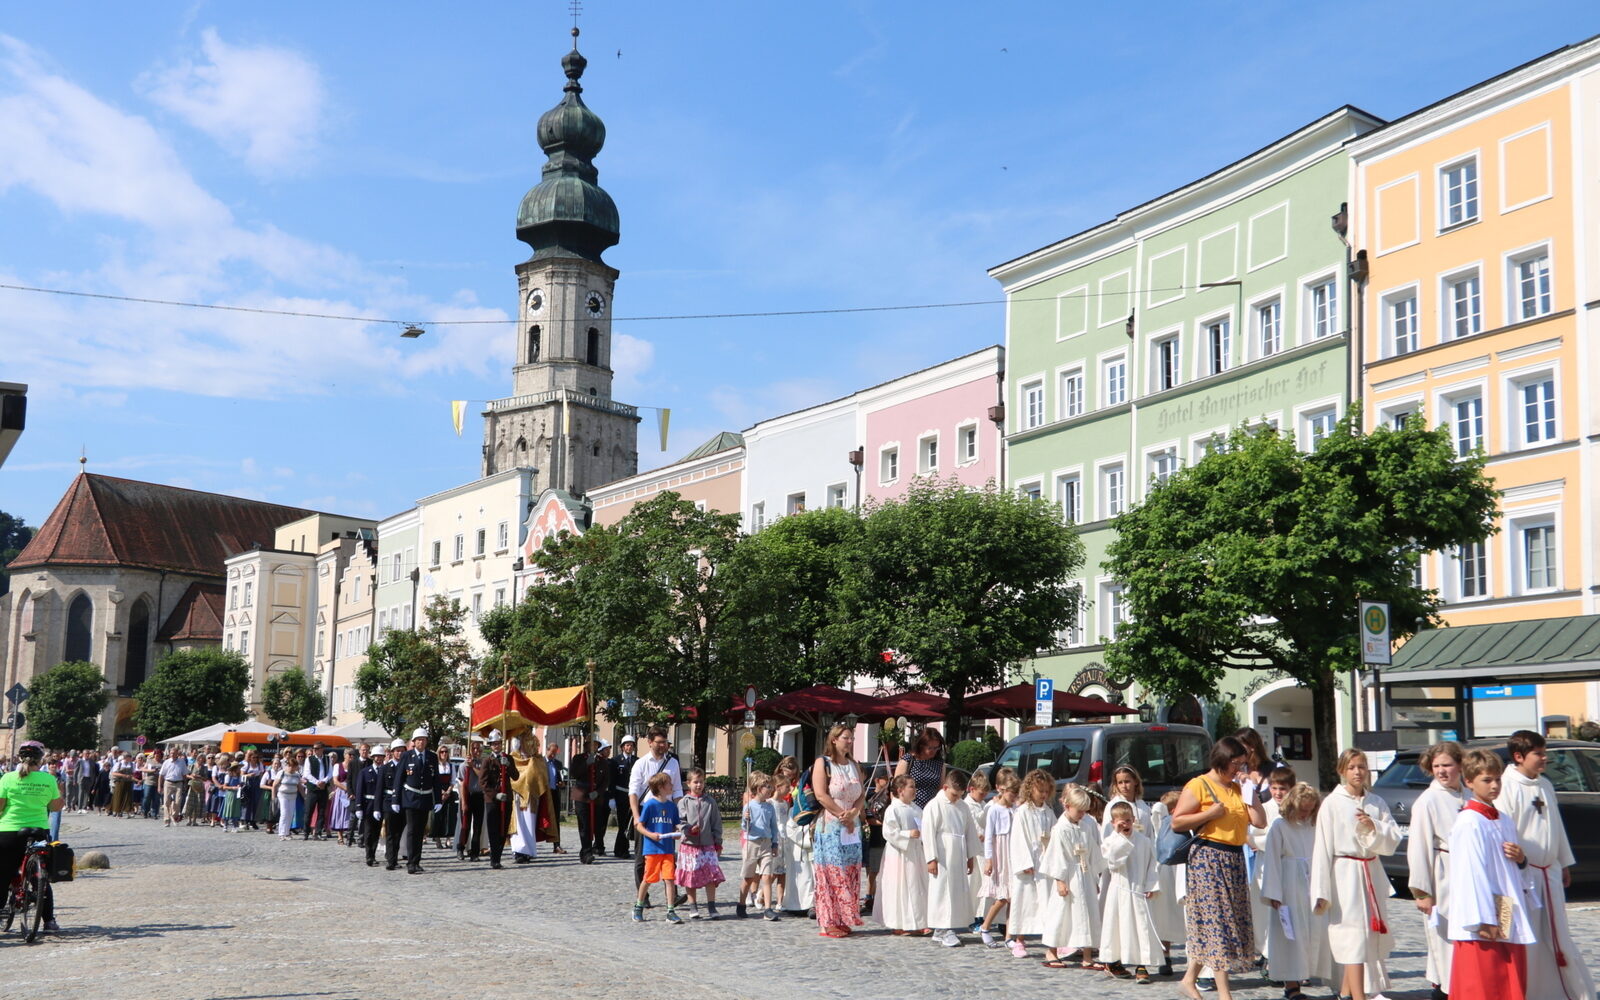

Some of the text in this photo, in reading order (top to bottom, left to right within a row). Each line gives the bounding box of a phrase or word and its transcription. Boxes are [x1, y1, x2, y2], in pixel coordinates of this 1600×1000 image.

[1157, 360, 1328, 433] Hotel Bayerischer Hof
[1040, 681, 1050, 698] P
